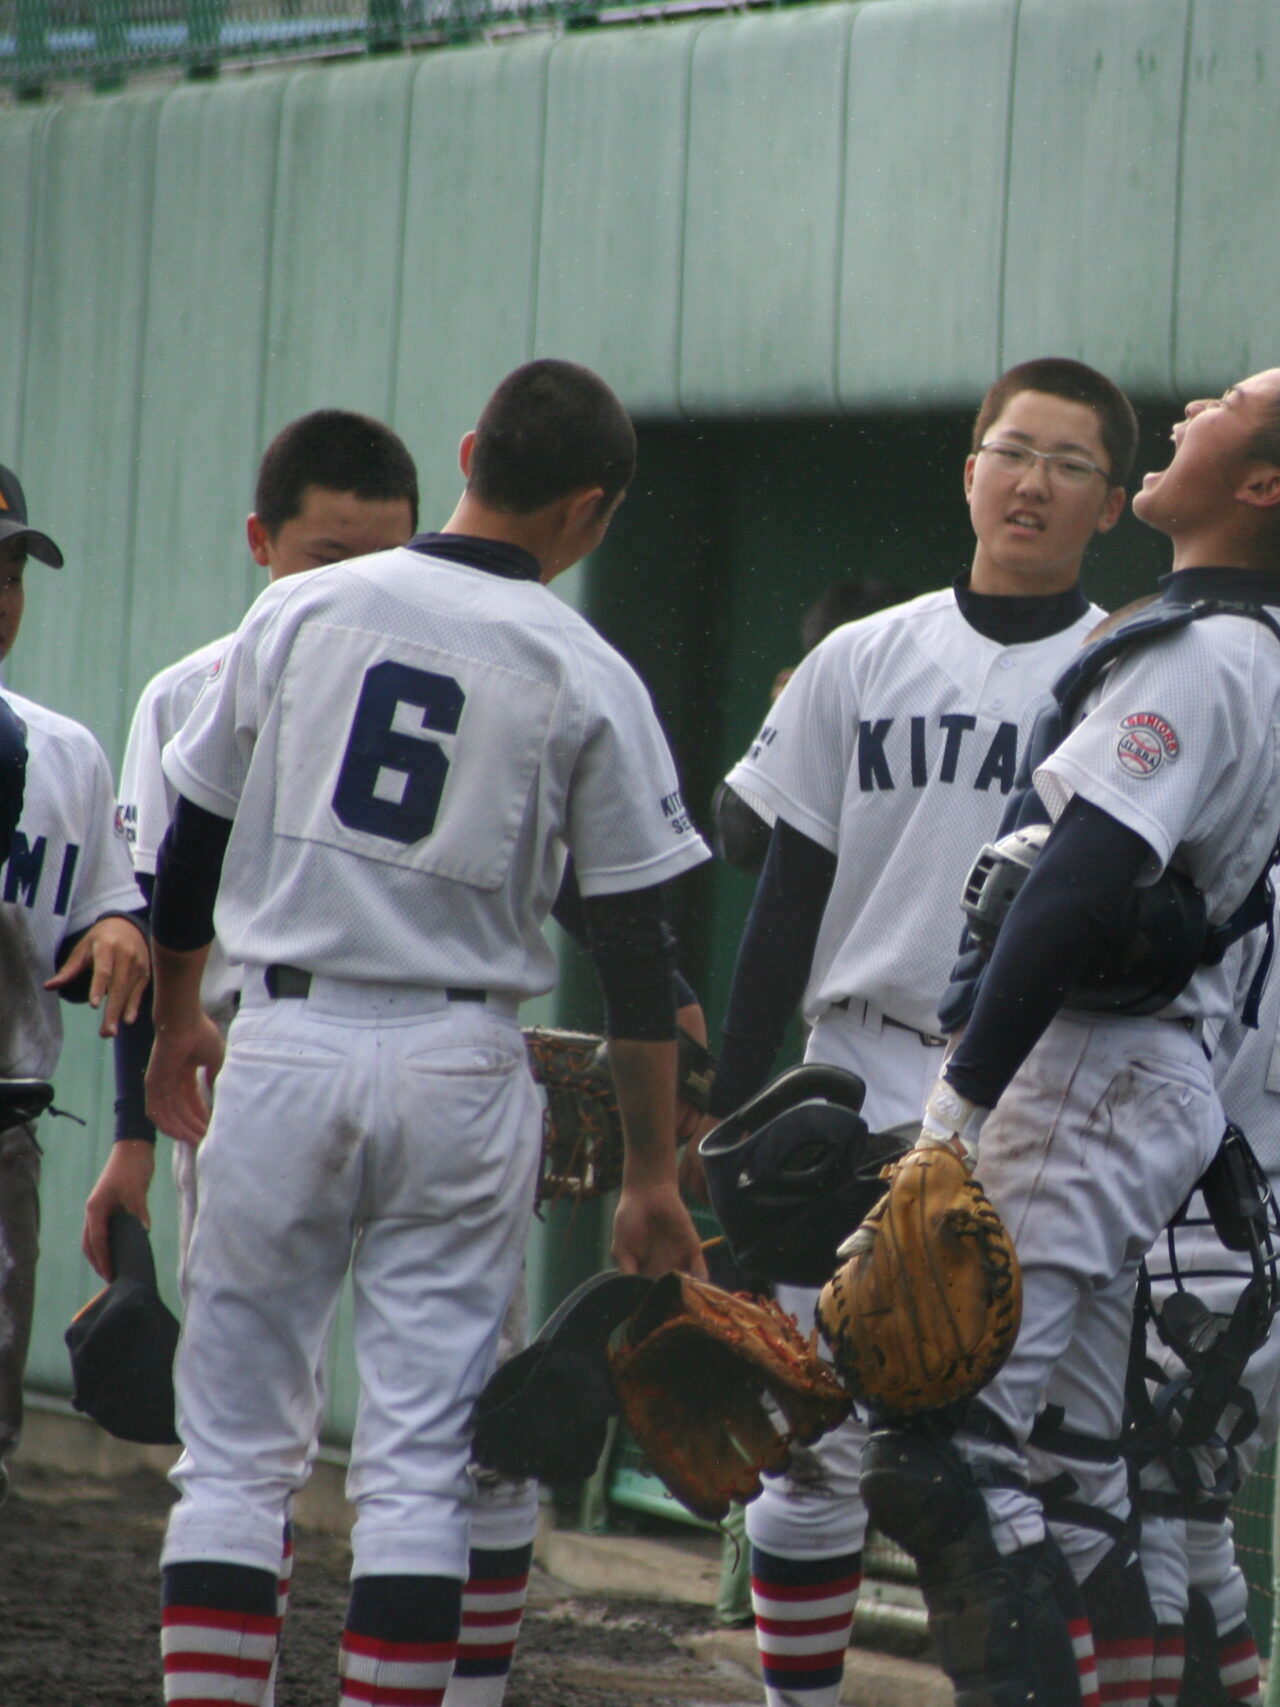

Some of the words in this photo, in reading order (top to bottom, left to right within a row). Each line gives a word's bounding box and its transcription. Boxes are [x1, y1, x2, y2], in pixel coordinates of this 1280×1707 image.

[332, 660, 466, 844] 6
[858, 714, 1018, 795] KITA
[3, 831, 80, 916] MI
